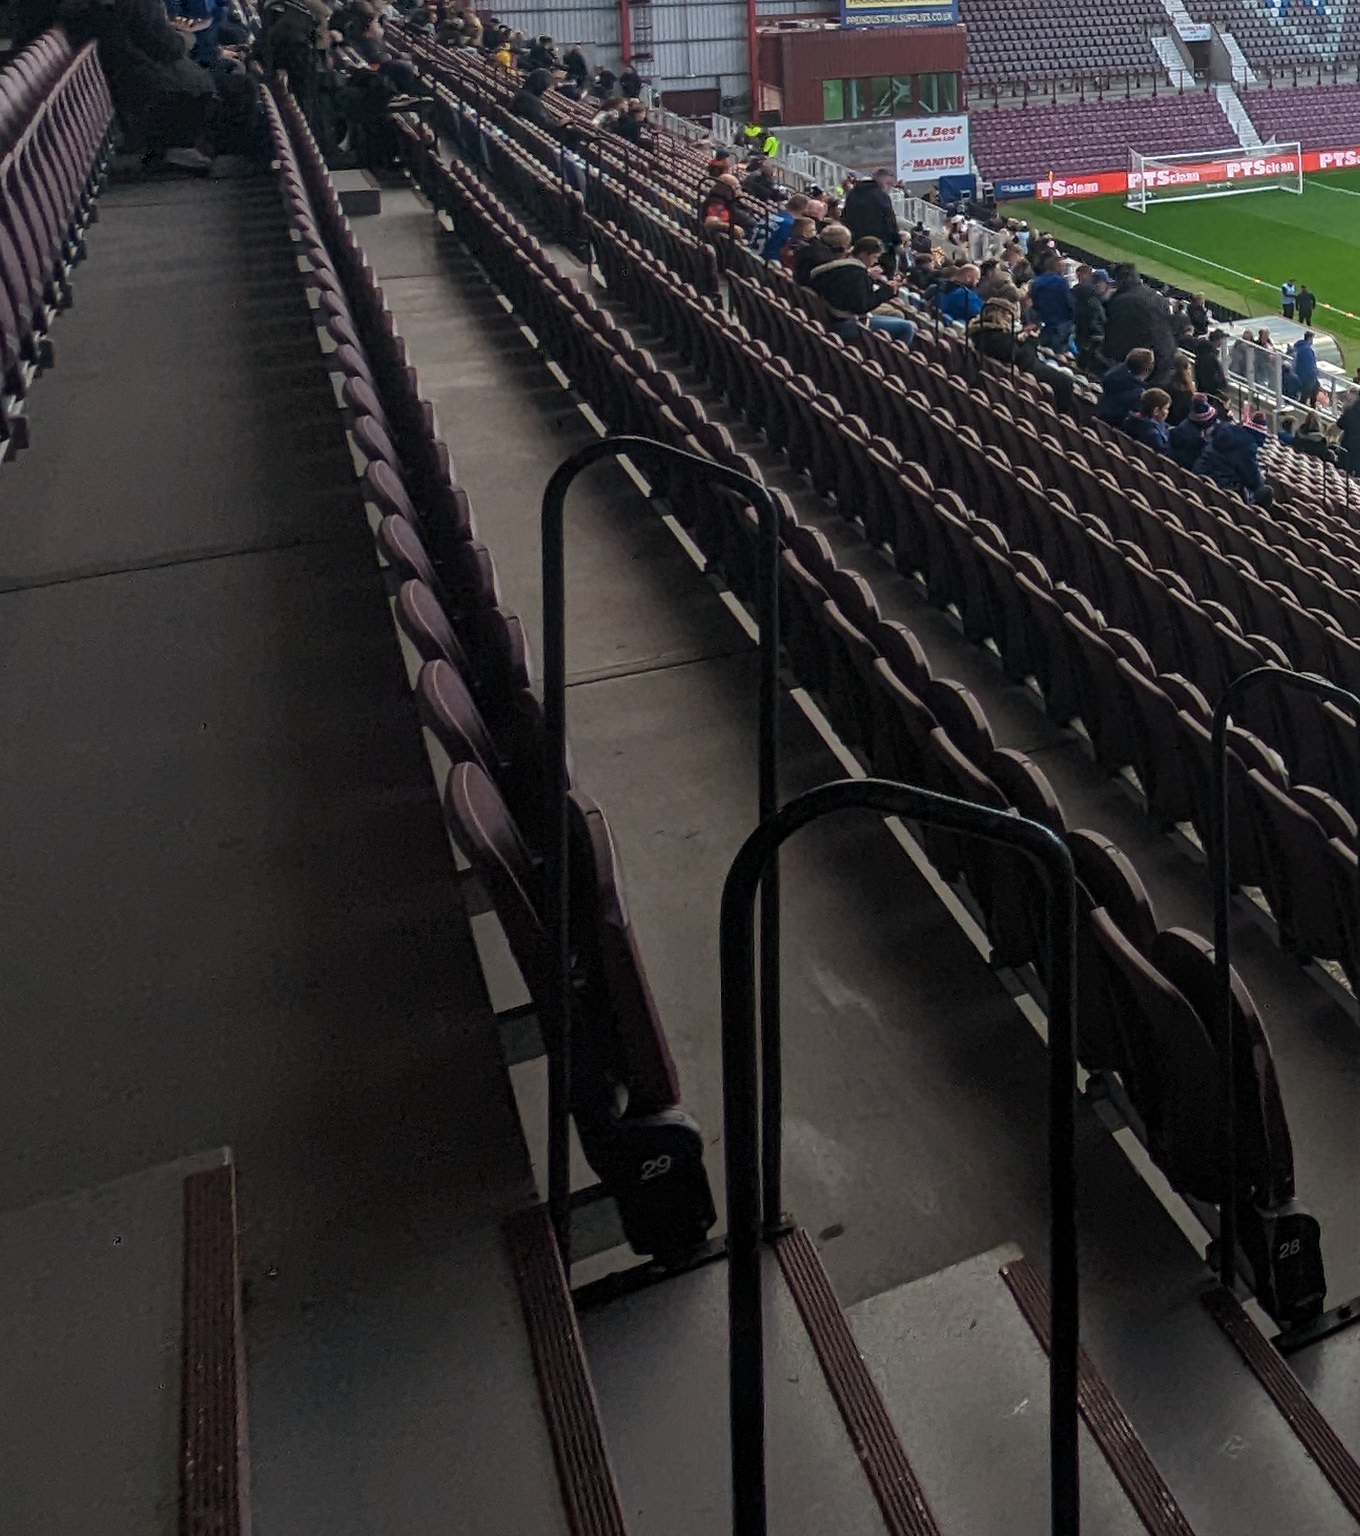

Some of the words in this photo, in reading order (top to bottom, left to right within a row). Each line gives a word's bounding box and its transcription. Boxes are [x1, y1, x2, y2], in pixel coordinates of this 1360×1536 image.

[902, 128, 927, 138] A.T.
[932, 125, 962, 136] Best
[913, 156, 965, 167] MANITOU
[1227, 159, 1294, 177] PTSclean
[1128, 170, 1199, 188] PTSclean
[642, 1154, 671, 1181] 29
[1279, 1239, 1301, 1260] 28
